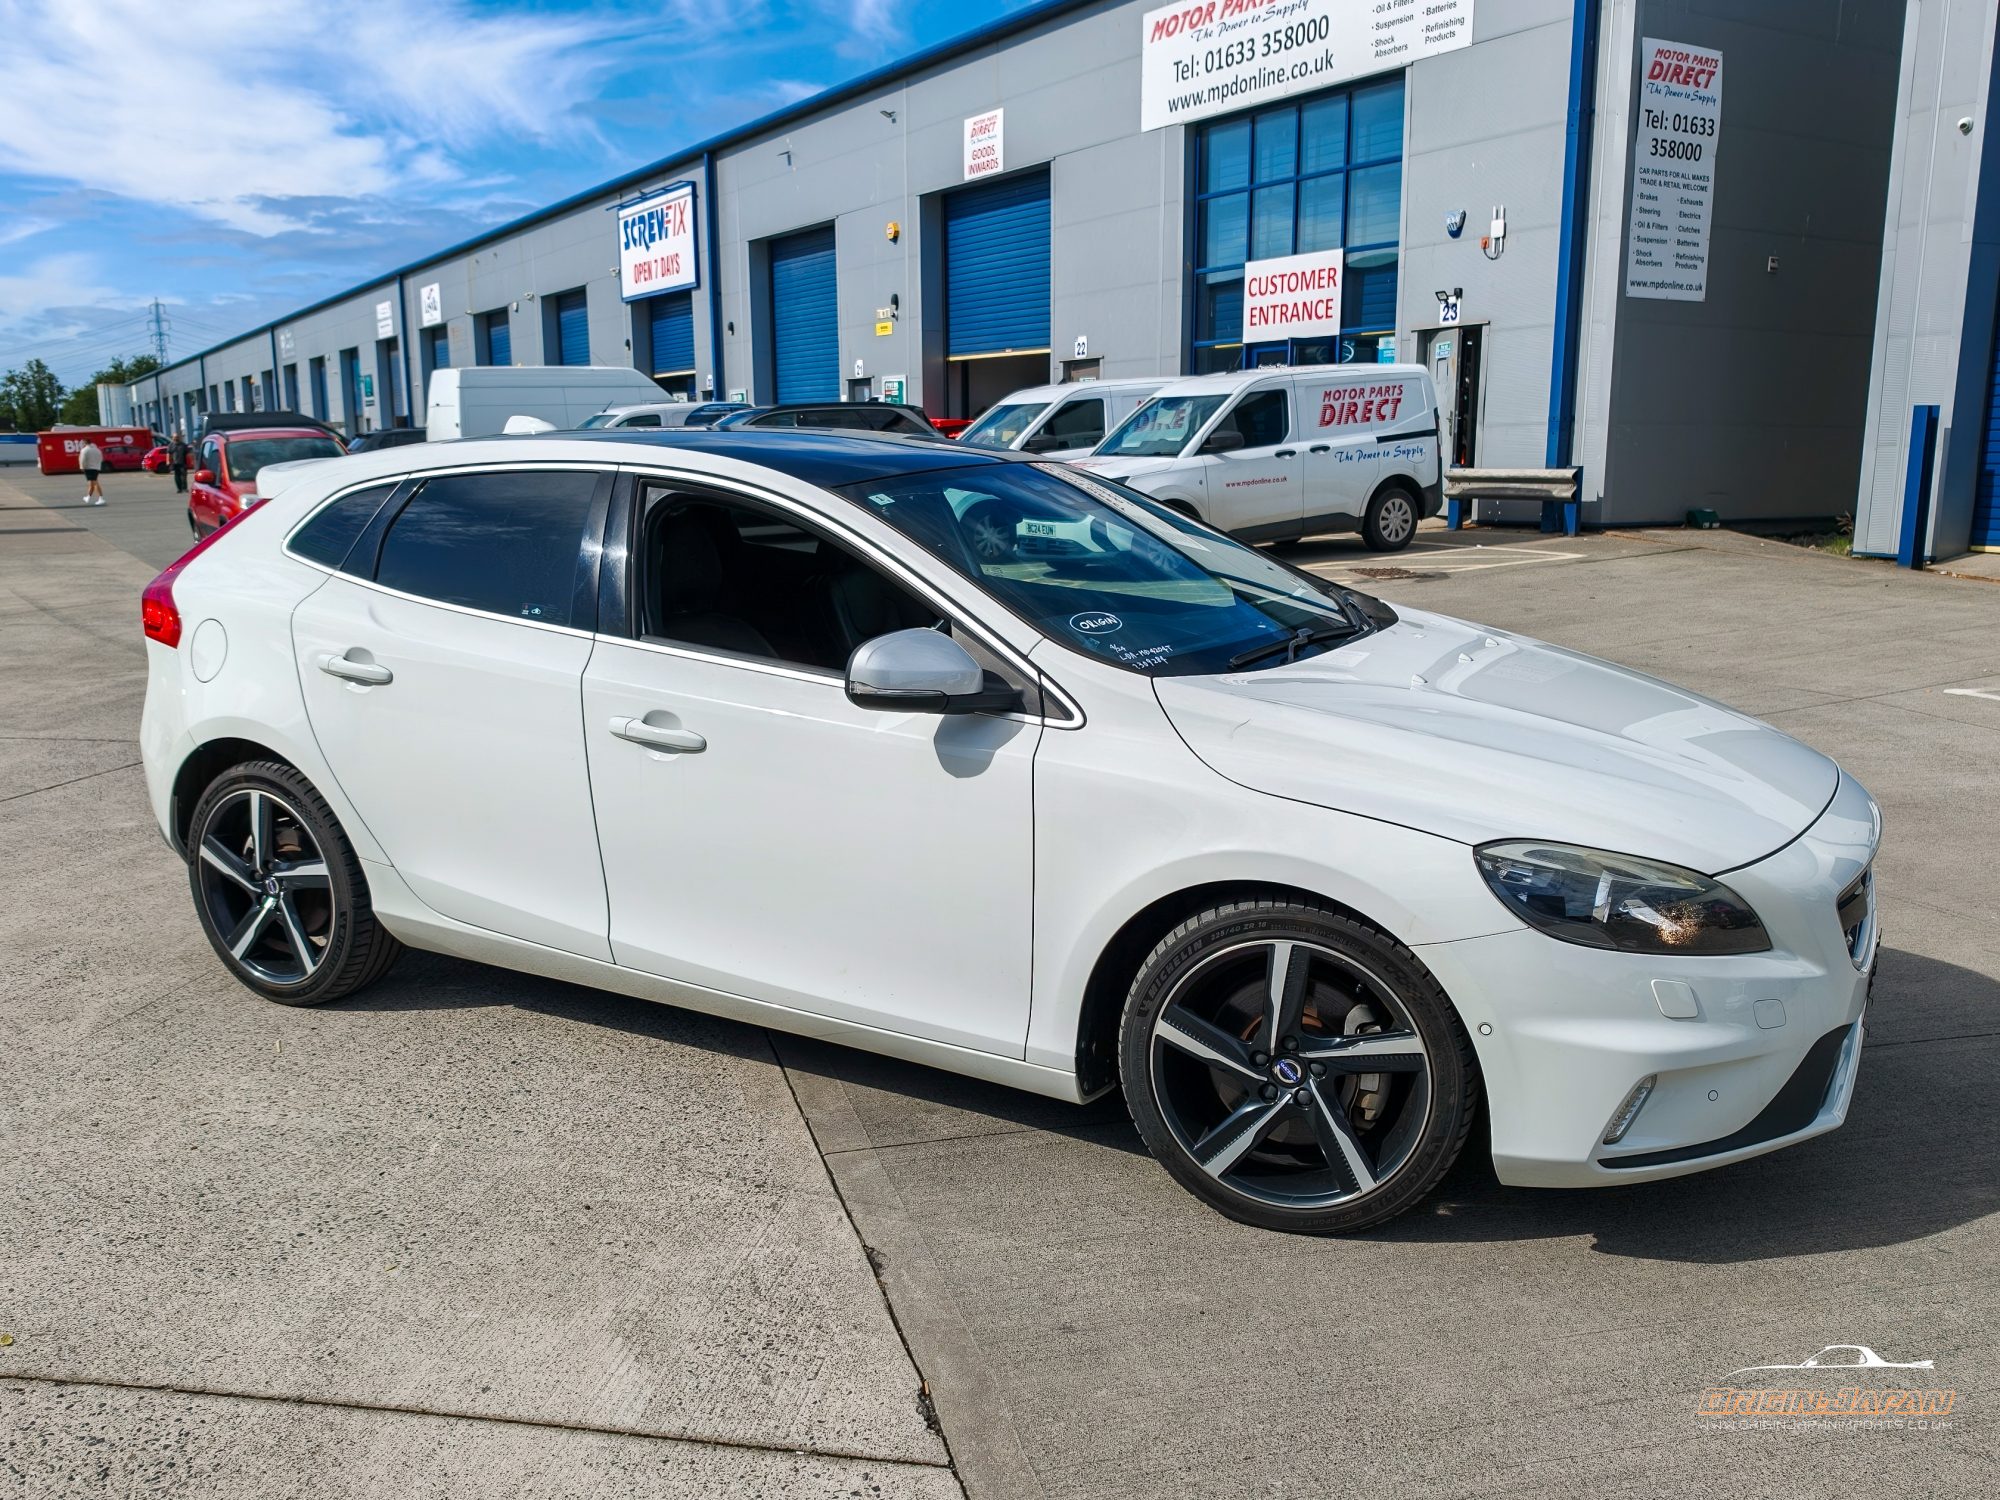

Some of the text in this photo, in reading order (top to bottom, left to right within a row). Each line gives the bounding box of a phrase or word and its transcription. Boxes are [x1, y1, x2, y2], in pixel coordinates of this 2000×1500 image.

[1376, 3, 1385, 14] Oil
[1386, 2, 1392, 11] &
[1426, 1, 1457, 16] Batteries
[1149, 1, 1216, 43] MOTOR
[1190, 0, 1309, 42] The Power to Supply
[1375, 13, 1414, 31] Suspension
[1425, 16, 1465, 34] Refinishing
[1374, 35, 1395, 48] Shock
[1424, 29, 1456, 45] Products
[1174, 14, 1330, 83] Tel: 01633 358000
[1374, 43, 1409, 59] Absorbers
[1655, 47, 1720, 69] MOTOR PARTS
[1168, 48, 1335, 114] www.mpdonline.co.uk
[1647, 60, 1716, 89] DIRECT
[1645, 82, 1717, 107] The Power to Supply
[1645, 109, 1715, 137] Tel: 01633
[972, 144, 996, 160] GOODS
[1650, 137, 1702, 162] 358000
[968, 157, 999, 175] INWARDS
[1639, 167, 1710, 183] CAR PARTS FOR ALL MAKES
[1640, 178, 1708, 193] TRADE & RETAIL WELCOME
[1640, 192, 1658, 201] Brakes
[1680, 196, 1704, 207] Exhausts
[1639, 206, 1661, 217] Steering
[1679, 210, 1701, 220] Electrics
[1637, 221, 1668, 231] Oil & Filters
[1678, 225, 1700, 234] Clutches
[1636, 235, 1668, 245] Suspension
[1676, 239, 1699, 248] Batteries
[1635, 249, 1652, 258] Shock
[1676, 252, 1705, 264] Refinishing
[634, 252, 681, 284] OPEN 7 DAYS
[1635, 258, 1663, 268] Absorbers
[1675, 261, 1698, 271] Products
[1248, 267, 1337, 298] CUSTOMER
[1629, 280, 1703, 292] www.mpdonline.co.uk
[1249, 298, 1334, 327] ENTRANCE
[1441, 303, 1458, 322] 23
[1077, 342, 1086, 356] 22
[1322, 384, 1404, 402] MOTOR PARTS
[1318, 397, 1402, 428] DIRECT
[1334, 445, 1424, 463] The Power to Supply
[1225, 475, 1288, 488] www.mpdonline.co.uk
[1079, 615, 1118, 629] ORIGIN
[1148, 938, 1203, 999] MICHELIN
